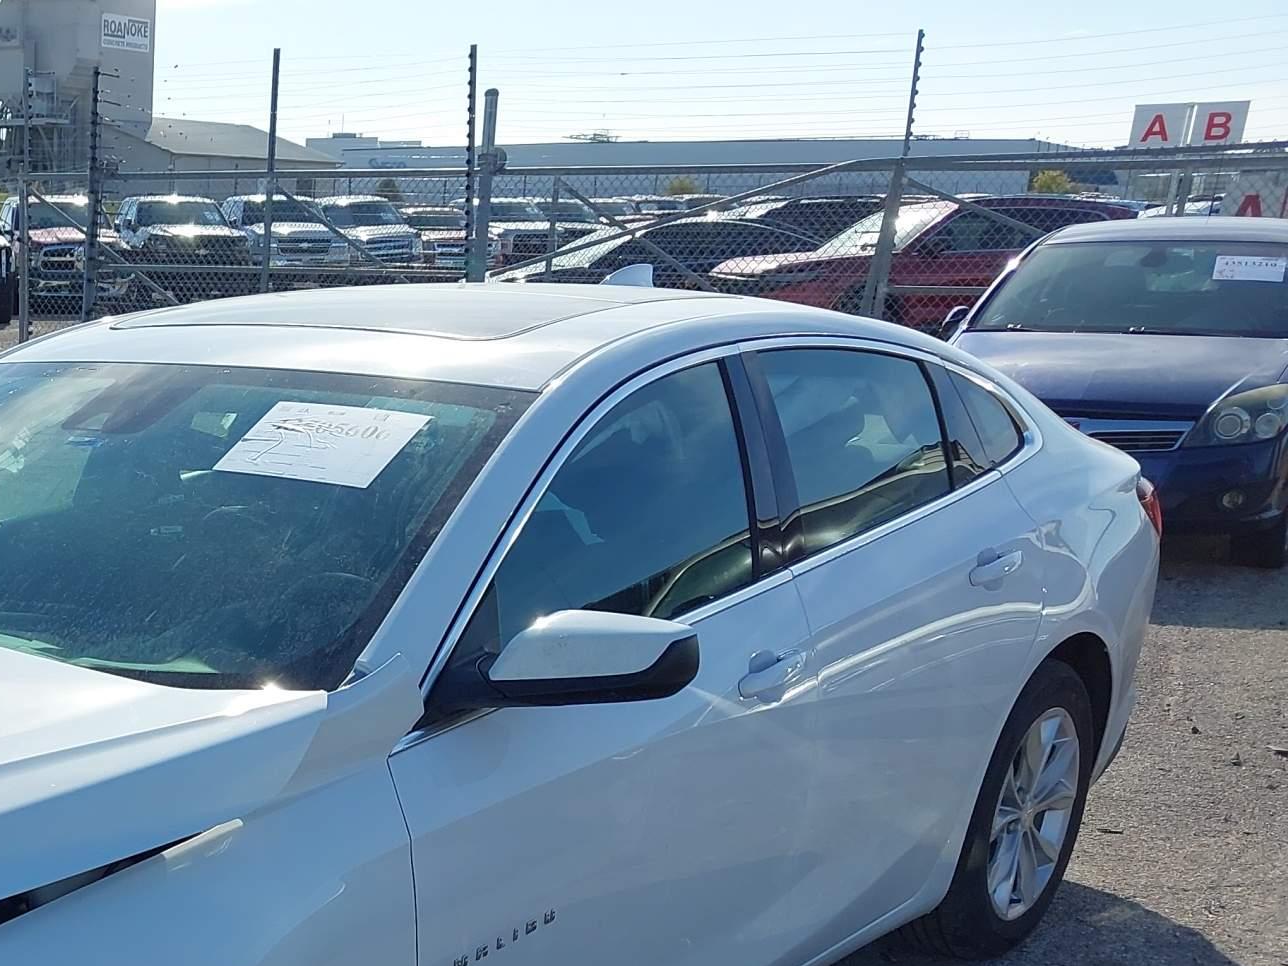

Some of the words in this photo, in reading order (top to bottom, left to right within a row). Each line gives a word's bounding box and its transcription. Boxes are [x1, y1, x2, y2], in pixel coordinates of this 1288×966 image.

[103, 19, 149, 39] ROANOKE
[1139, 113, 1168, 142] A
[1204, 112, 1232, 141] B
